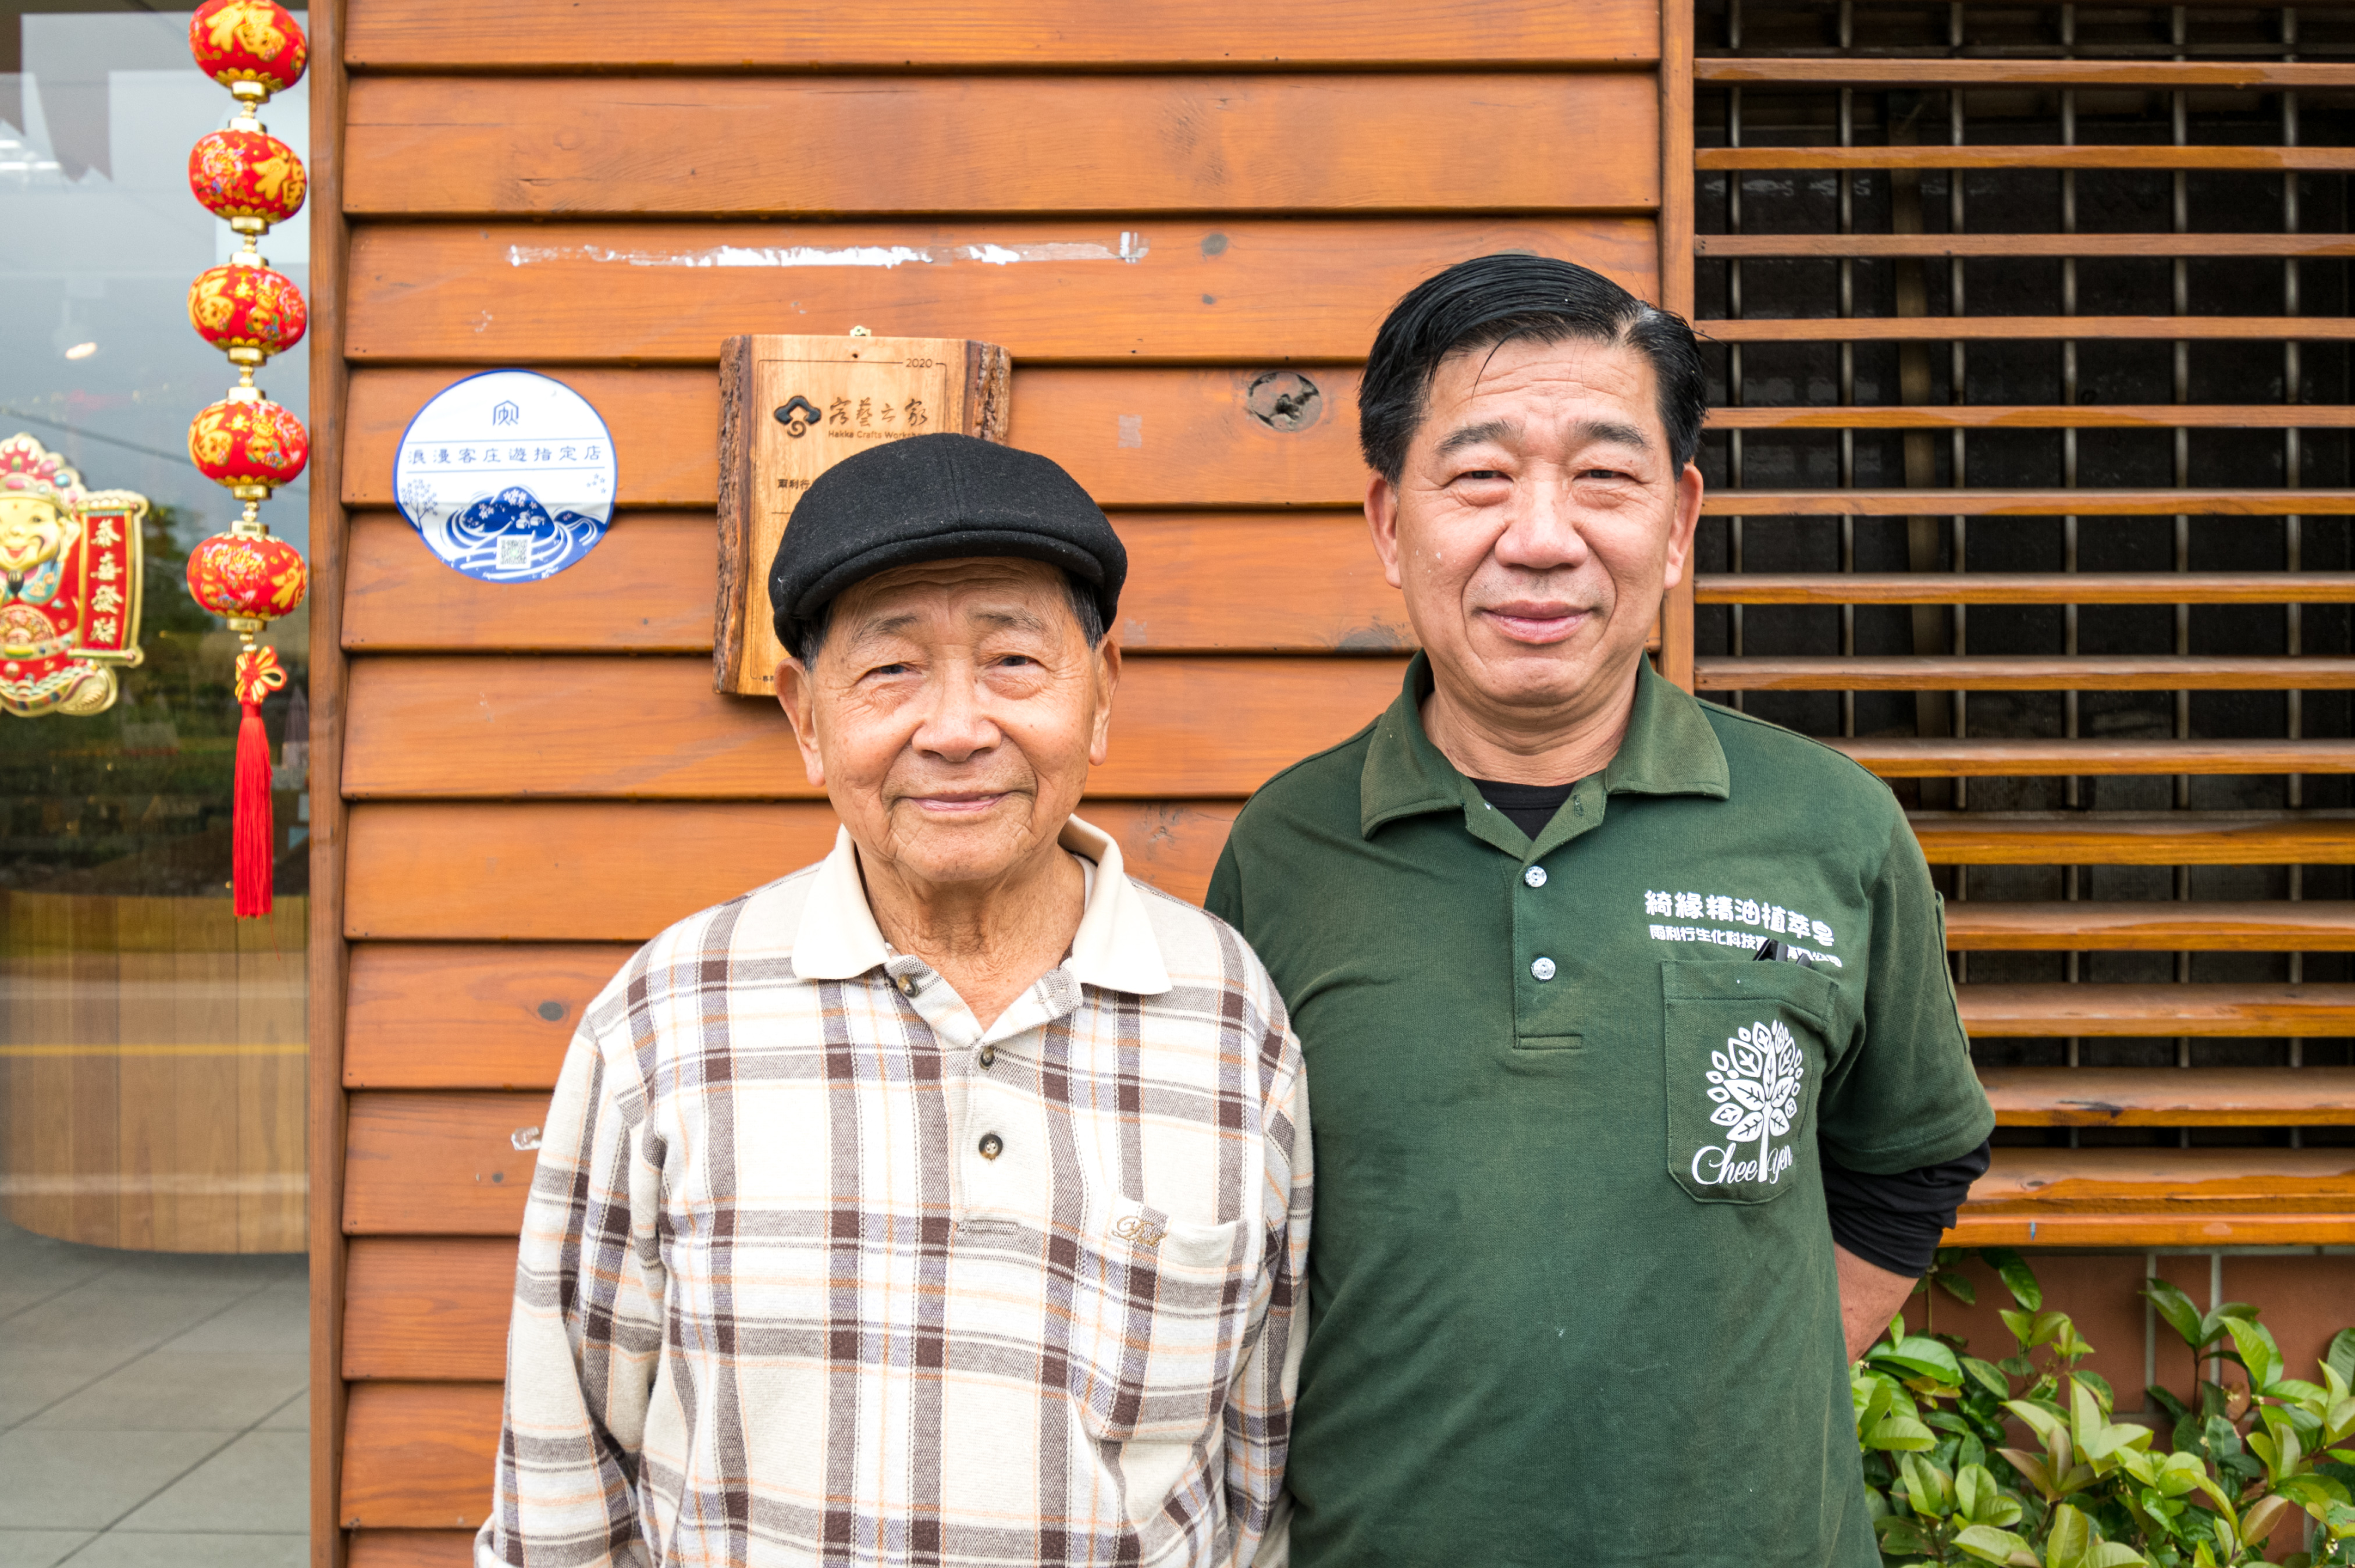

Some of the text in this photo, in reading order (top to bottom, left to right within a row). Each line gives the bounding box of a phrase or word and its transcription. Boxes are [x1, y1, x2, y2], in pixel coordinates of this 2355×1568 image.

[905, 358, 933, 368] 2020
[828, 430, 854, 439] Hakka
[856, 430, 882, 439] Crafts
[408, 446, 601, 465] 浪漫客庄遊指定店
